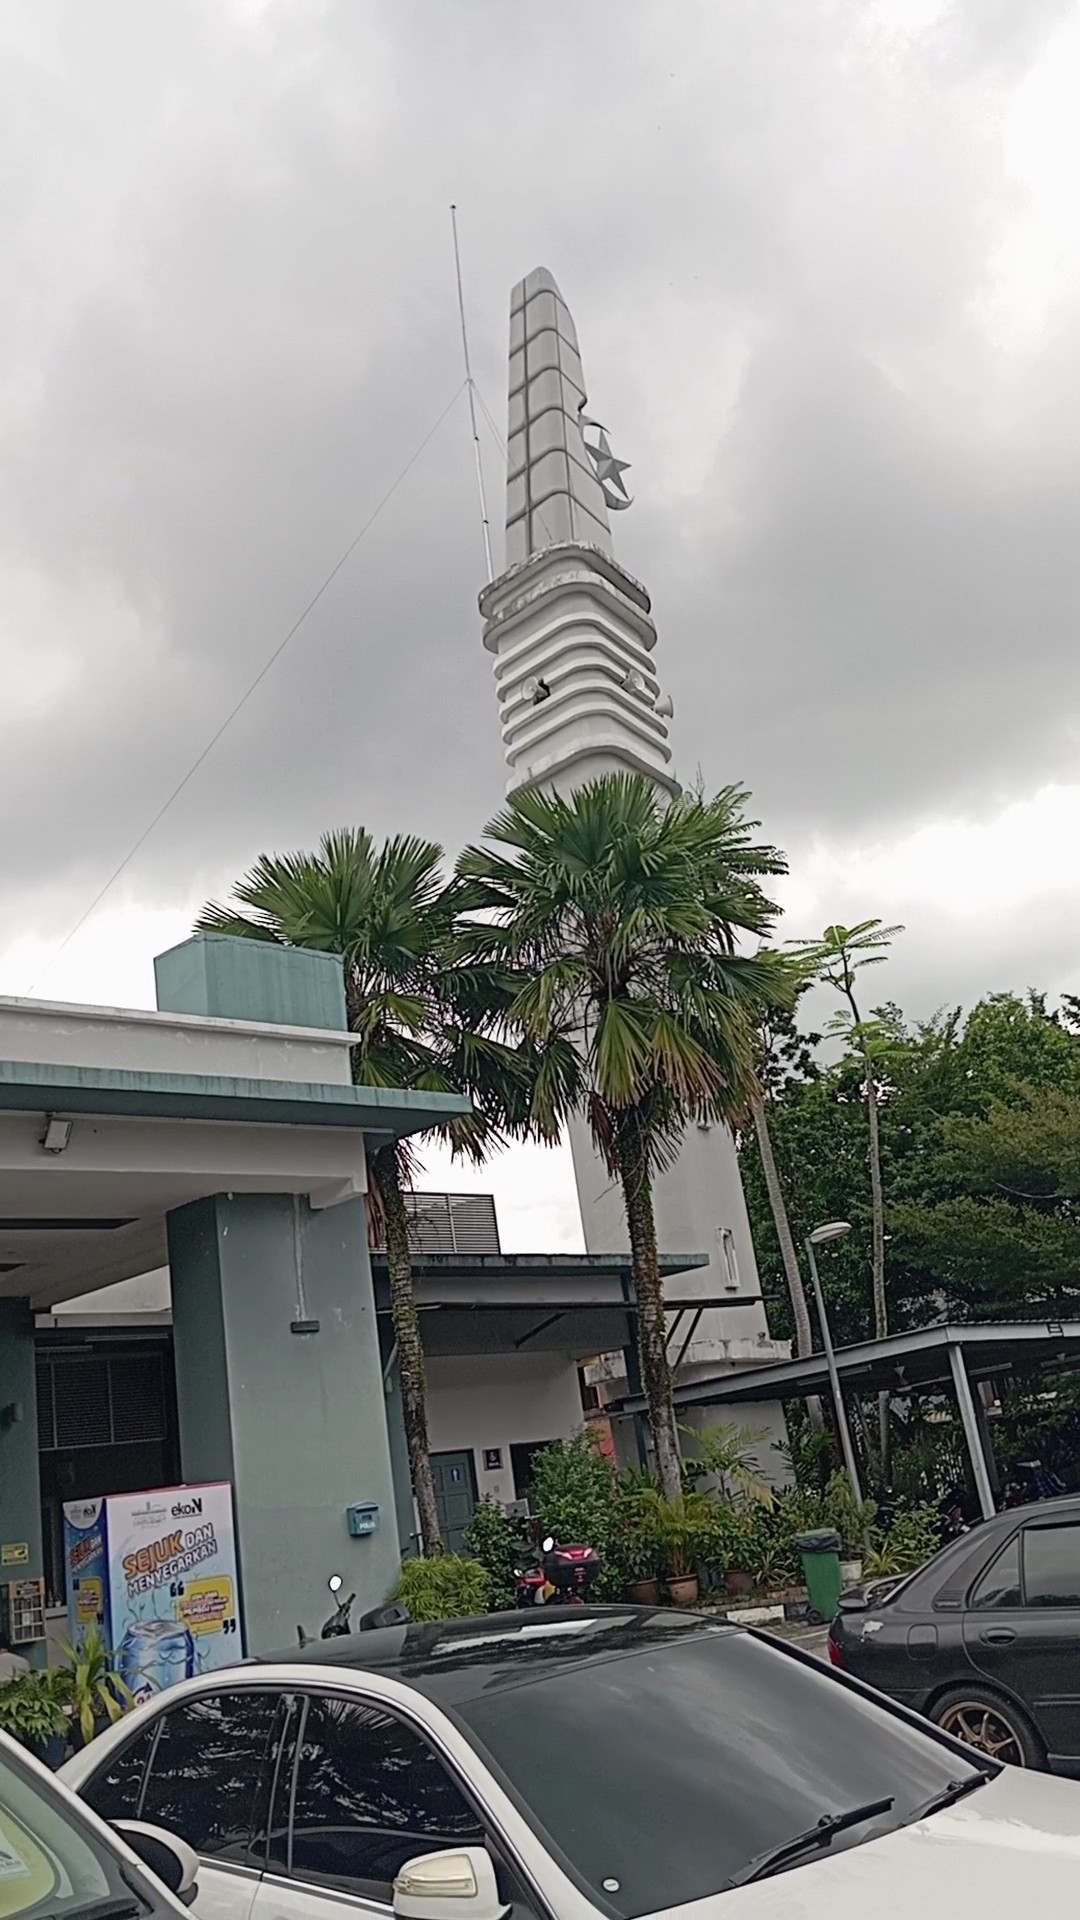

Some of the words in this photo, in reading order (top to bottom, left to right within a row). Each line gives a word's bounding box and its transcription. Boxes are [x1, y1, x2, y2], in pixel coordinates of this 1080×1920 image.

[123, 1530, 184, 1580] SEJUK
[185, 1523, 215, 1549] DAN
[127, 1540, 218, 1598] MENYEGARKAN
